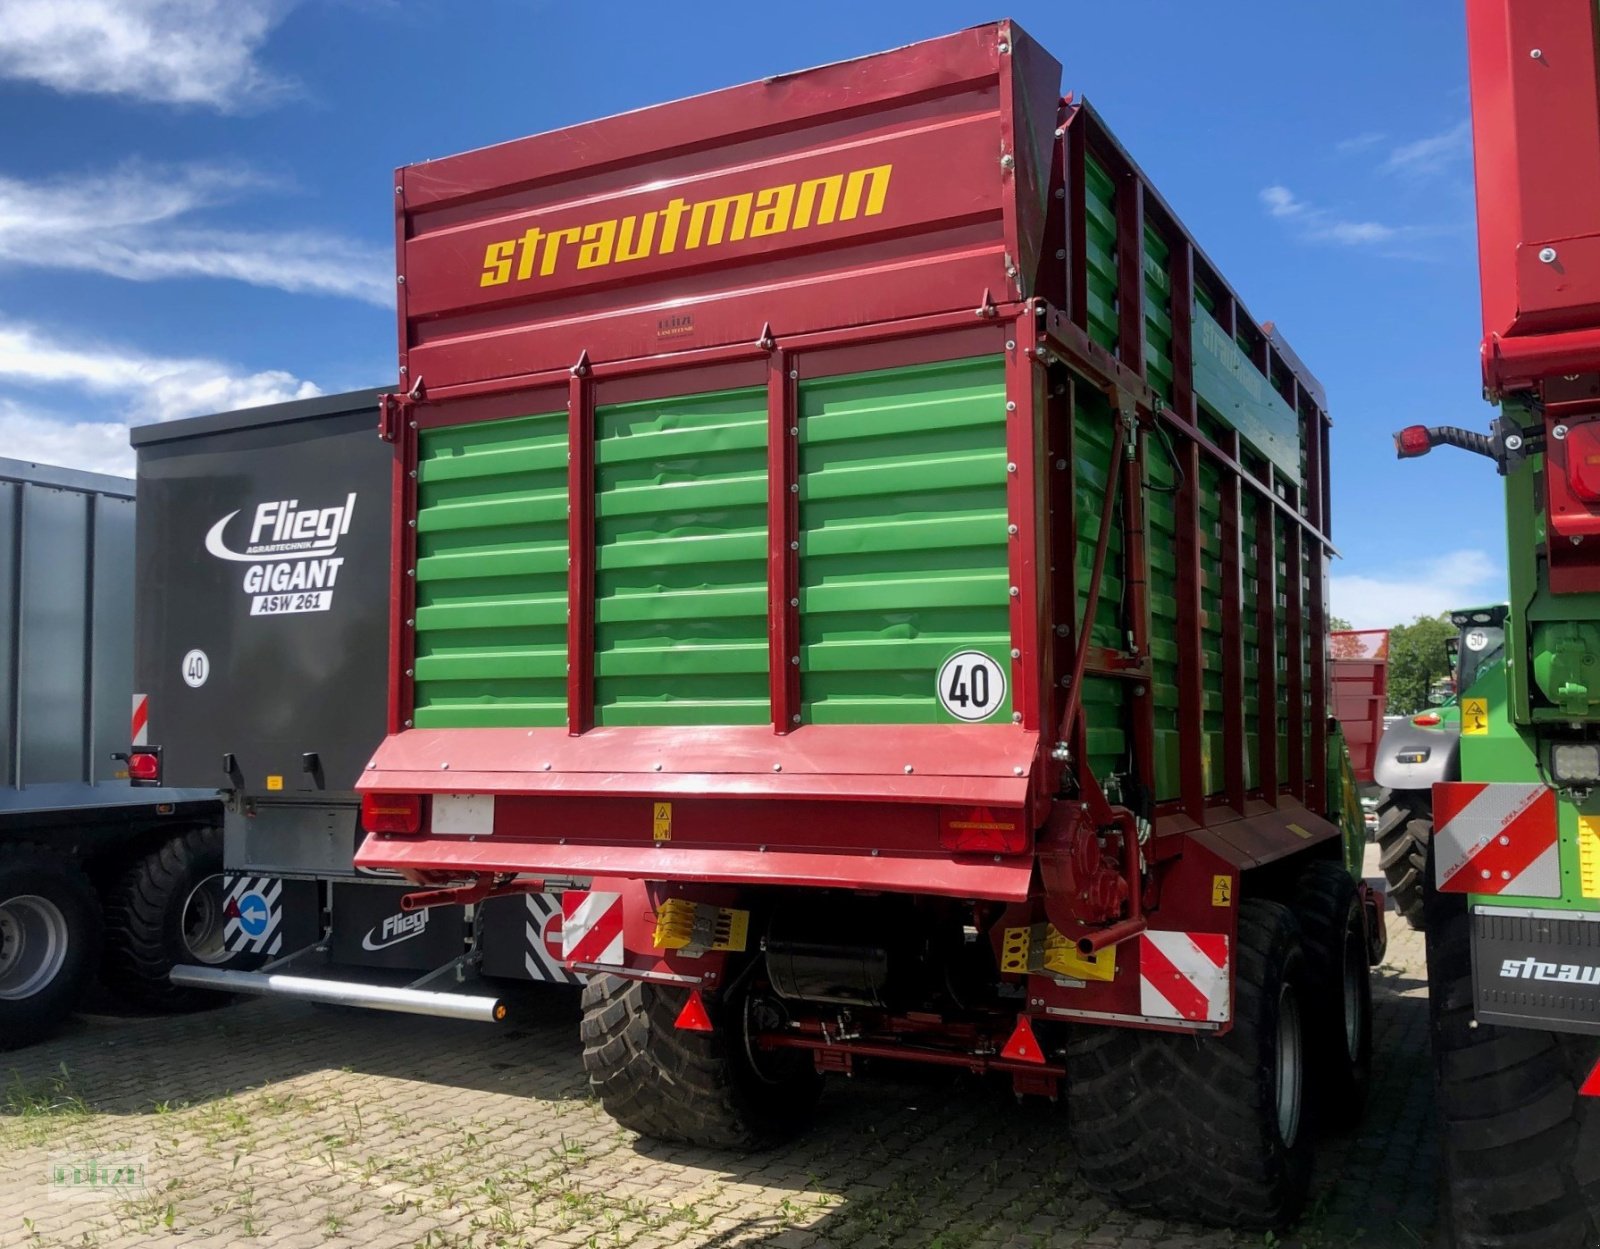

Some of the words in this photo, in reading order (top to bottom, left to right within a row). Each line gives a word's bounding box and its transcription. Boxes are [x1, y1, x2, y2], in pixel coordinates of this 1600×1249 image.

[480, 164, 893, 288] strautmann
[250, 492, 357, 548] Fliegl
[245, 541, 313, 554] AGRARTECHNIK
[243, 557, 345, 594] GIGANT
[258, 595, 293, 613] ASW
[295, 592, 321, 611] 261
[1471, 633, 1484, 646] 50
[188, 656, 203, 680] 40
[948, 664, 989, 708] 40
[382, 906, 430, 941] Fliegl
